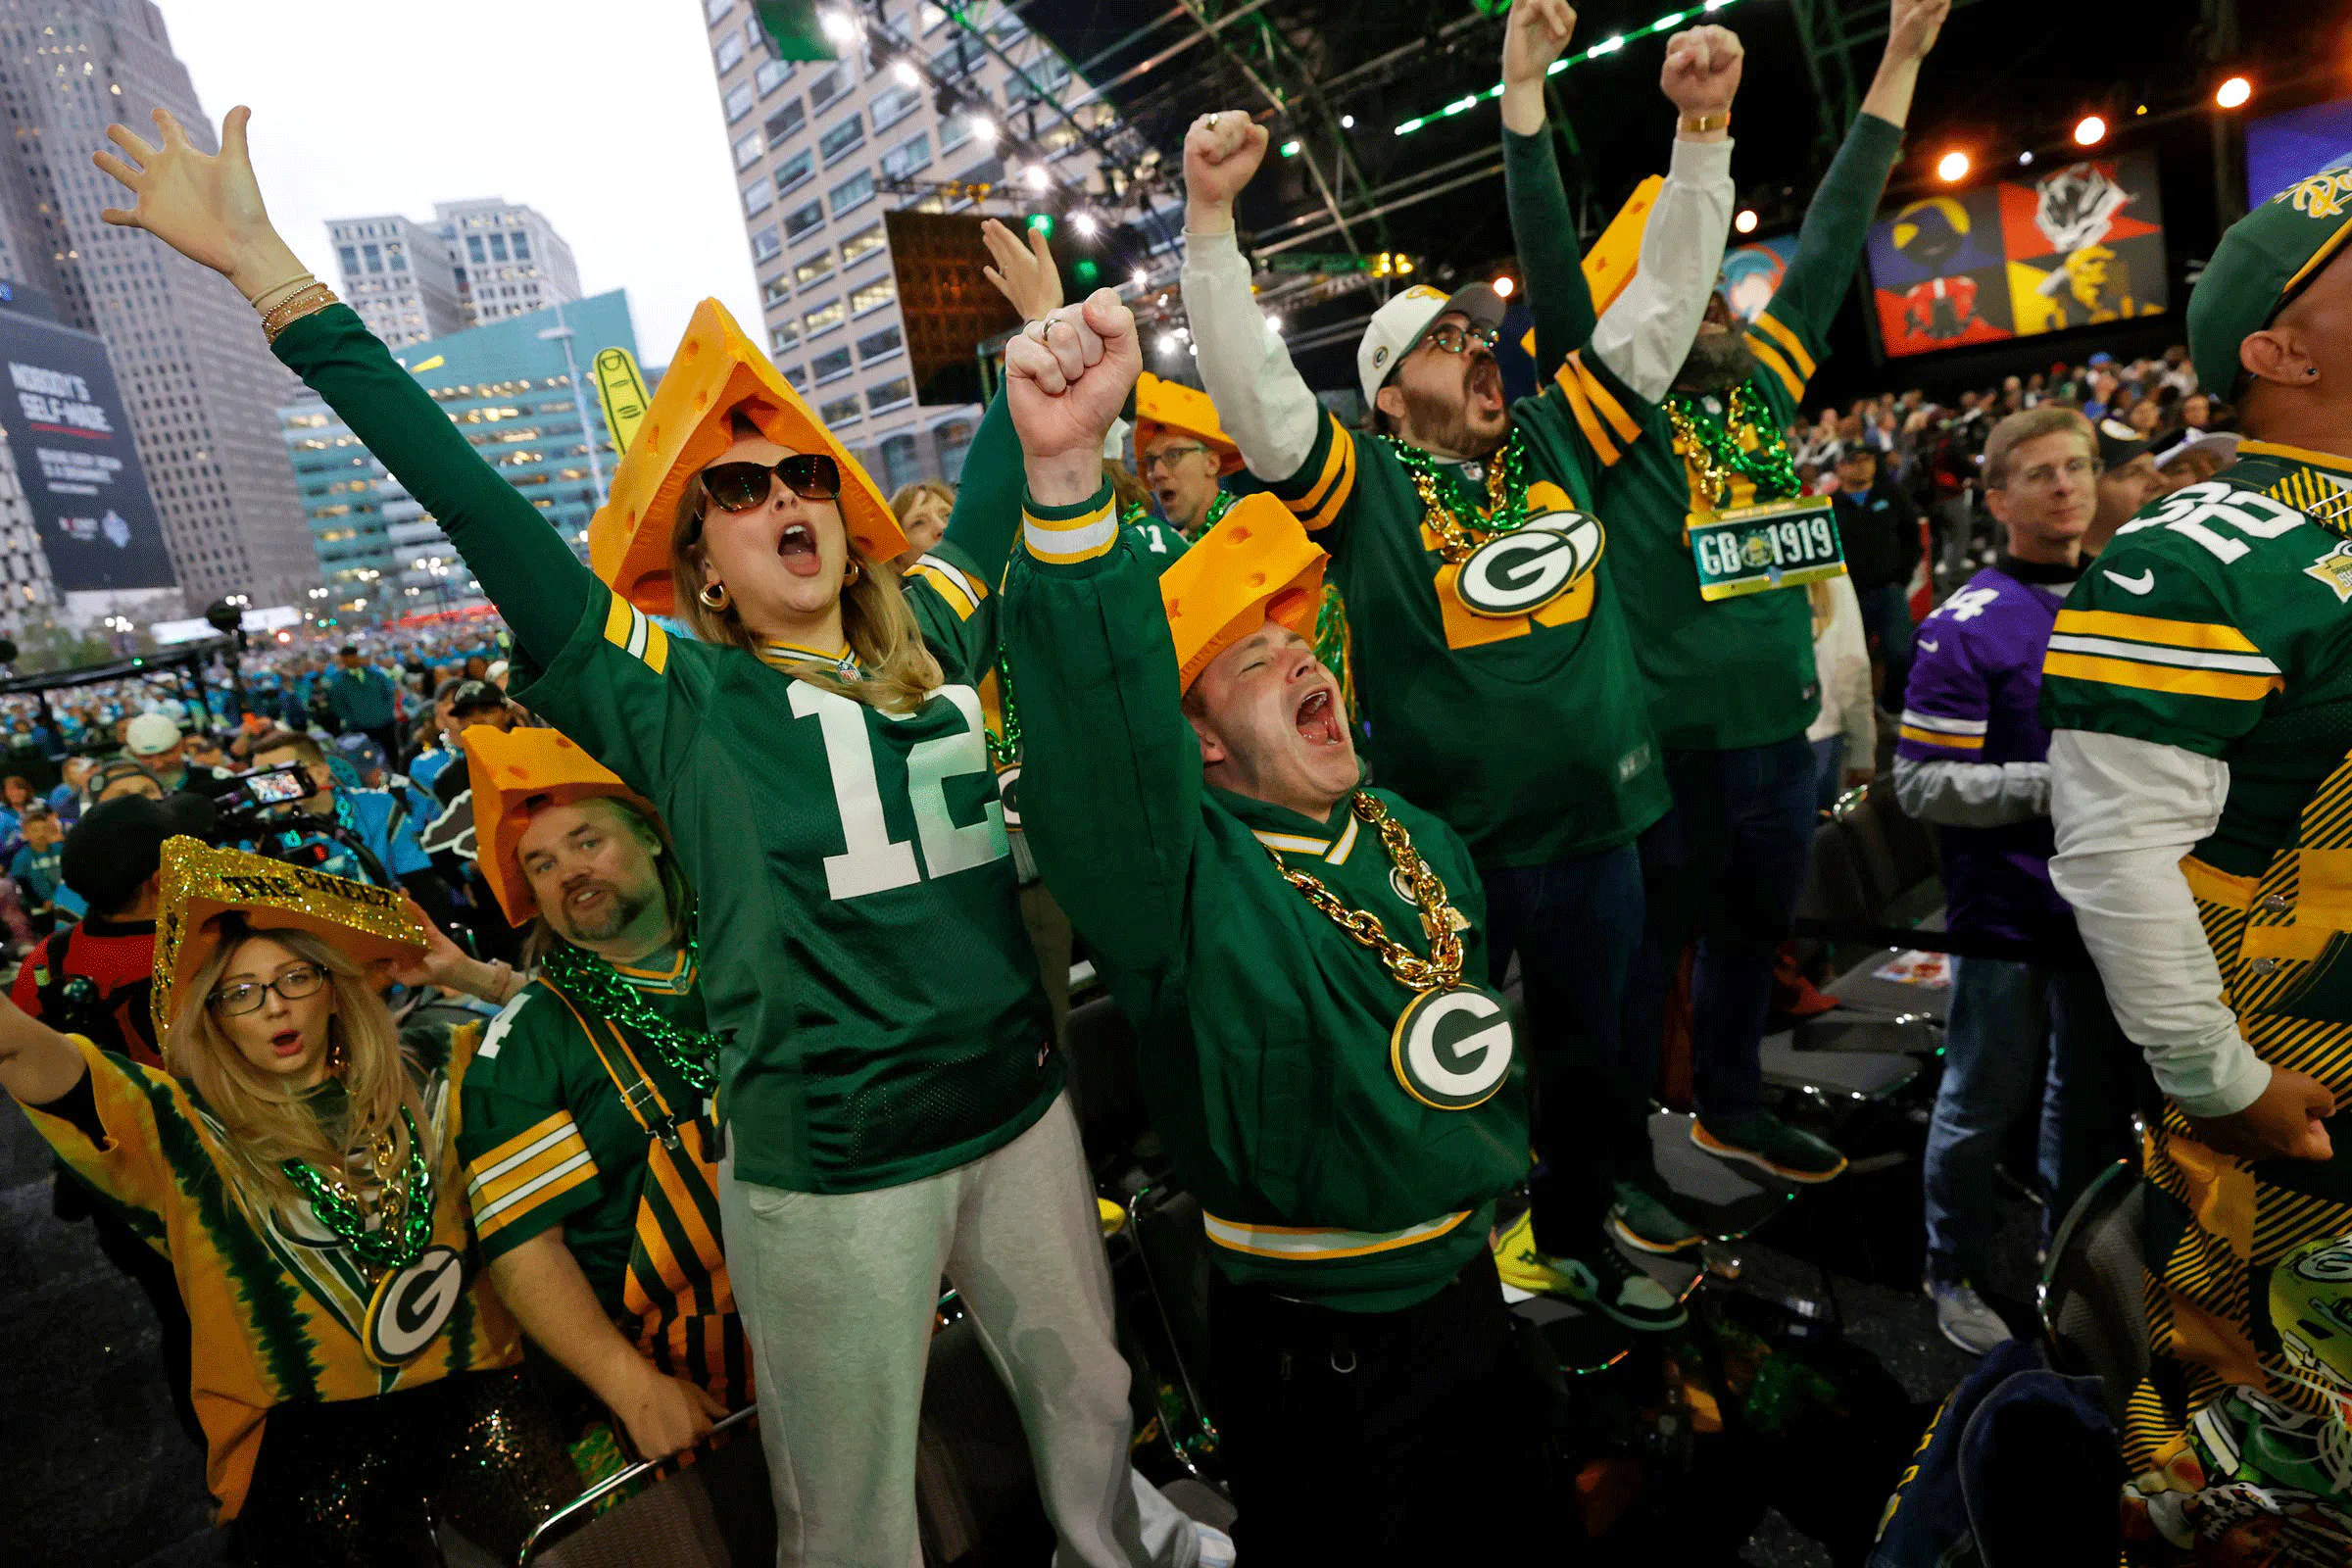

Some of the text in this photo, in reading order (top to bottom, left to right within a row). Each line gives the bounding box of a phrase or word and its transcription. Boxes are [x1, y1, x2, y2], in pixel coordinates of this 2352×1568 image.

[1463, 530, 1572, 607] G
[1699, 516, 1834, 575] GB 1919
[2116, 481, 2306, 565] 32
[786, 679, 1010, 901] 12
[1408, 992, 1512, 1096] G
[378, 1250, 461, 1355] G
